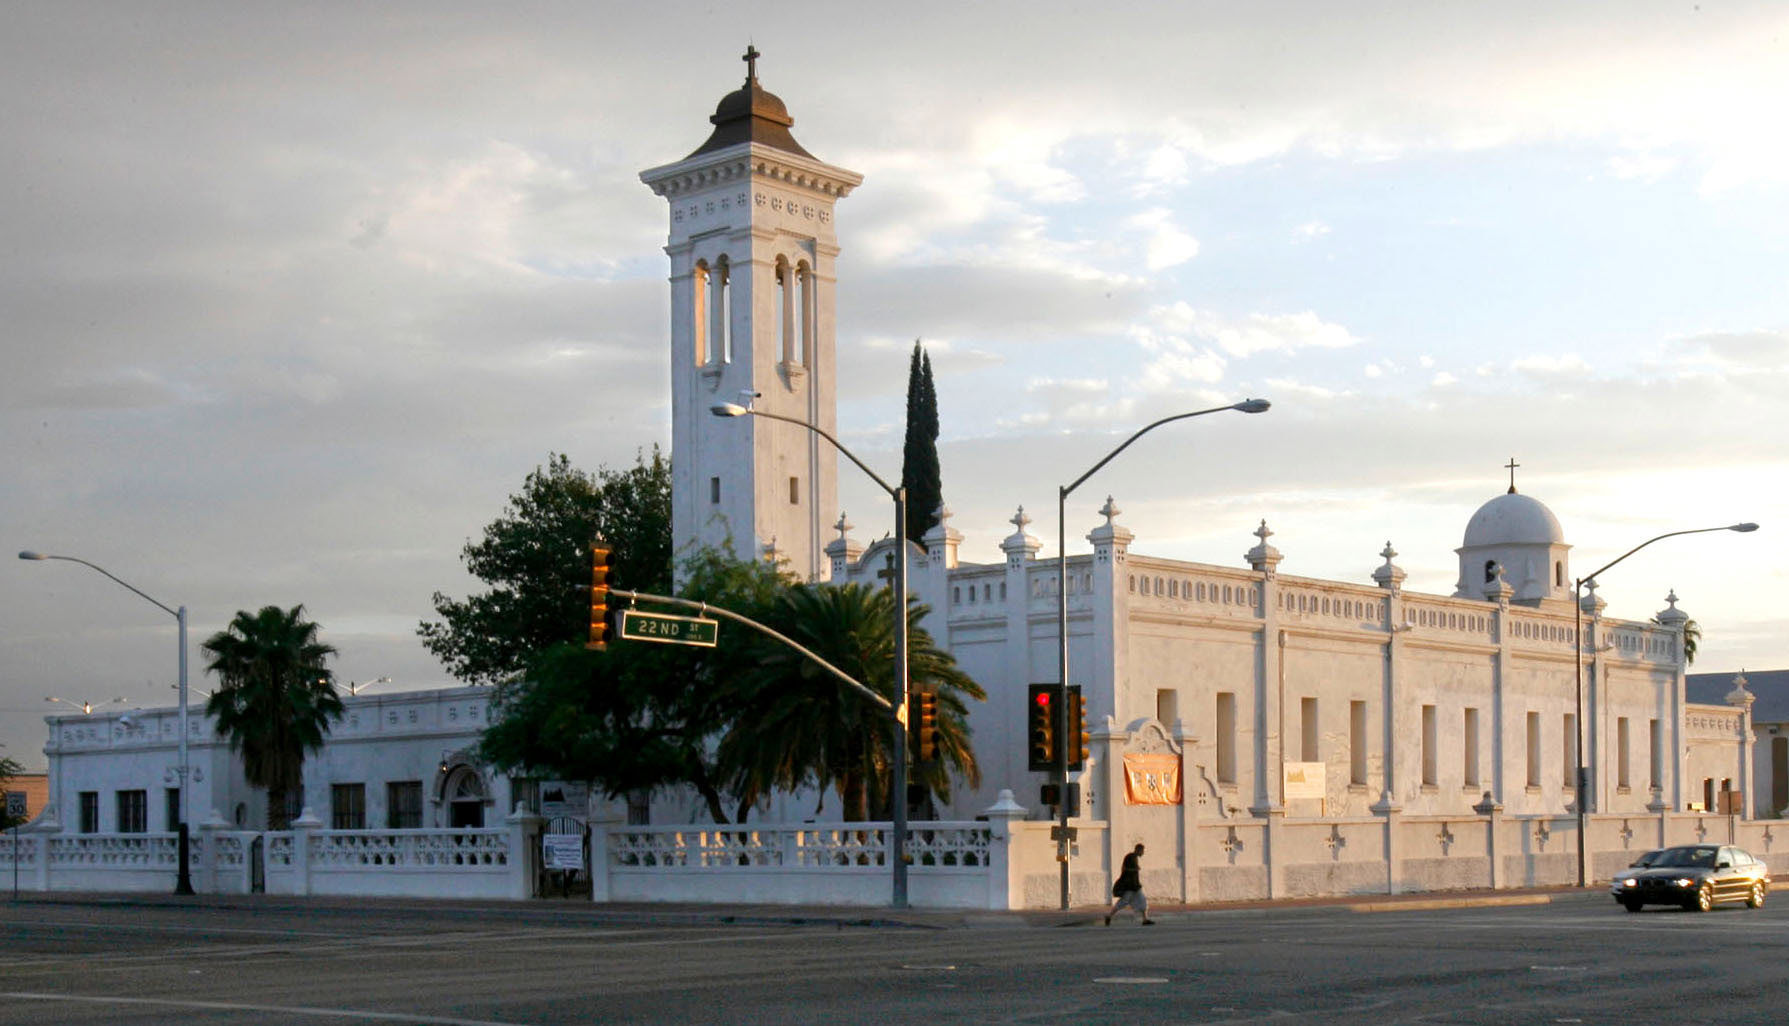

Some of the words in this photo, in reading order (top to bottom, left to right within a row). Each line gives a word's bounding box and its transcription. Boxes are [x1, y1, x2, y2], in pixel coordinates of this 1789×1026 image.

[639, 620, 679, 635] 22ND
[689, 623, 699, 632] ST
[9, 804, 24, 814] 30
